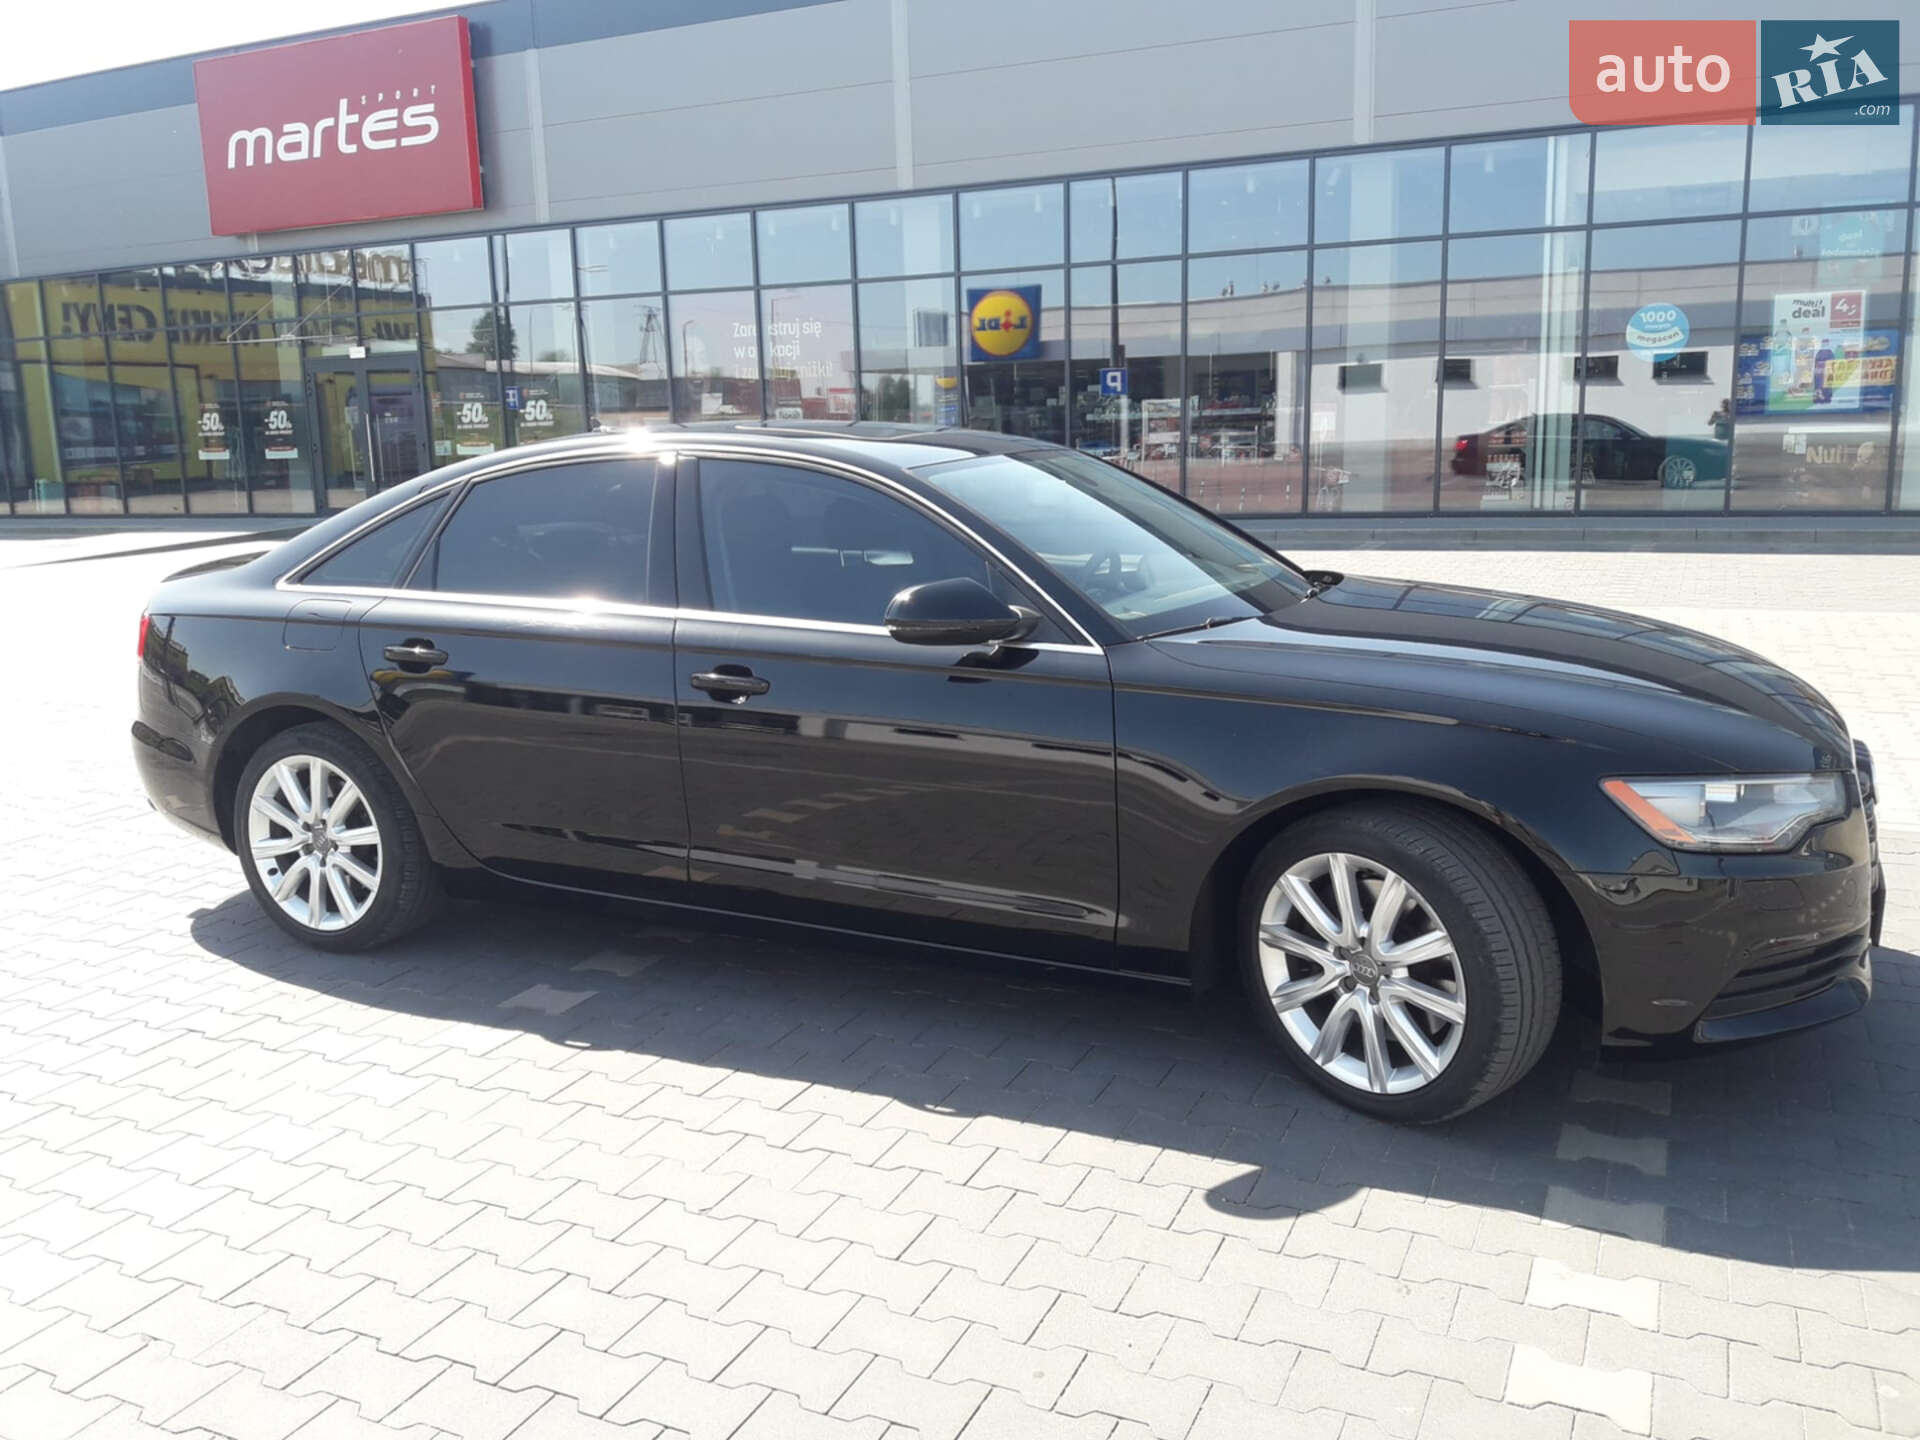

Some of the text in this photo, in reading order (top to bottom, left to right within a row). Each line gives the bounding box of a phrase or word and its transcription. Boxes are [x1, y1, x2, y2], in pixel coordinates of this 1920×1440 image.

[228, 98, 440, 169] martes
[1640, 310, 1677, 323] 1000
[1792, 306, 1825, 318] deal
[802, 317, 822, 338] się
